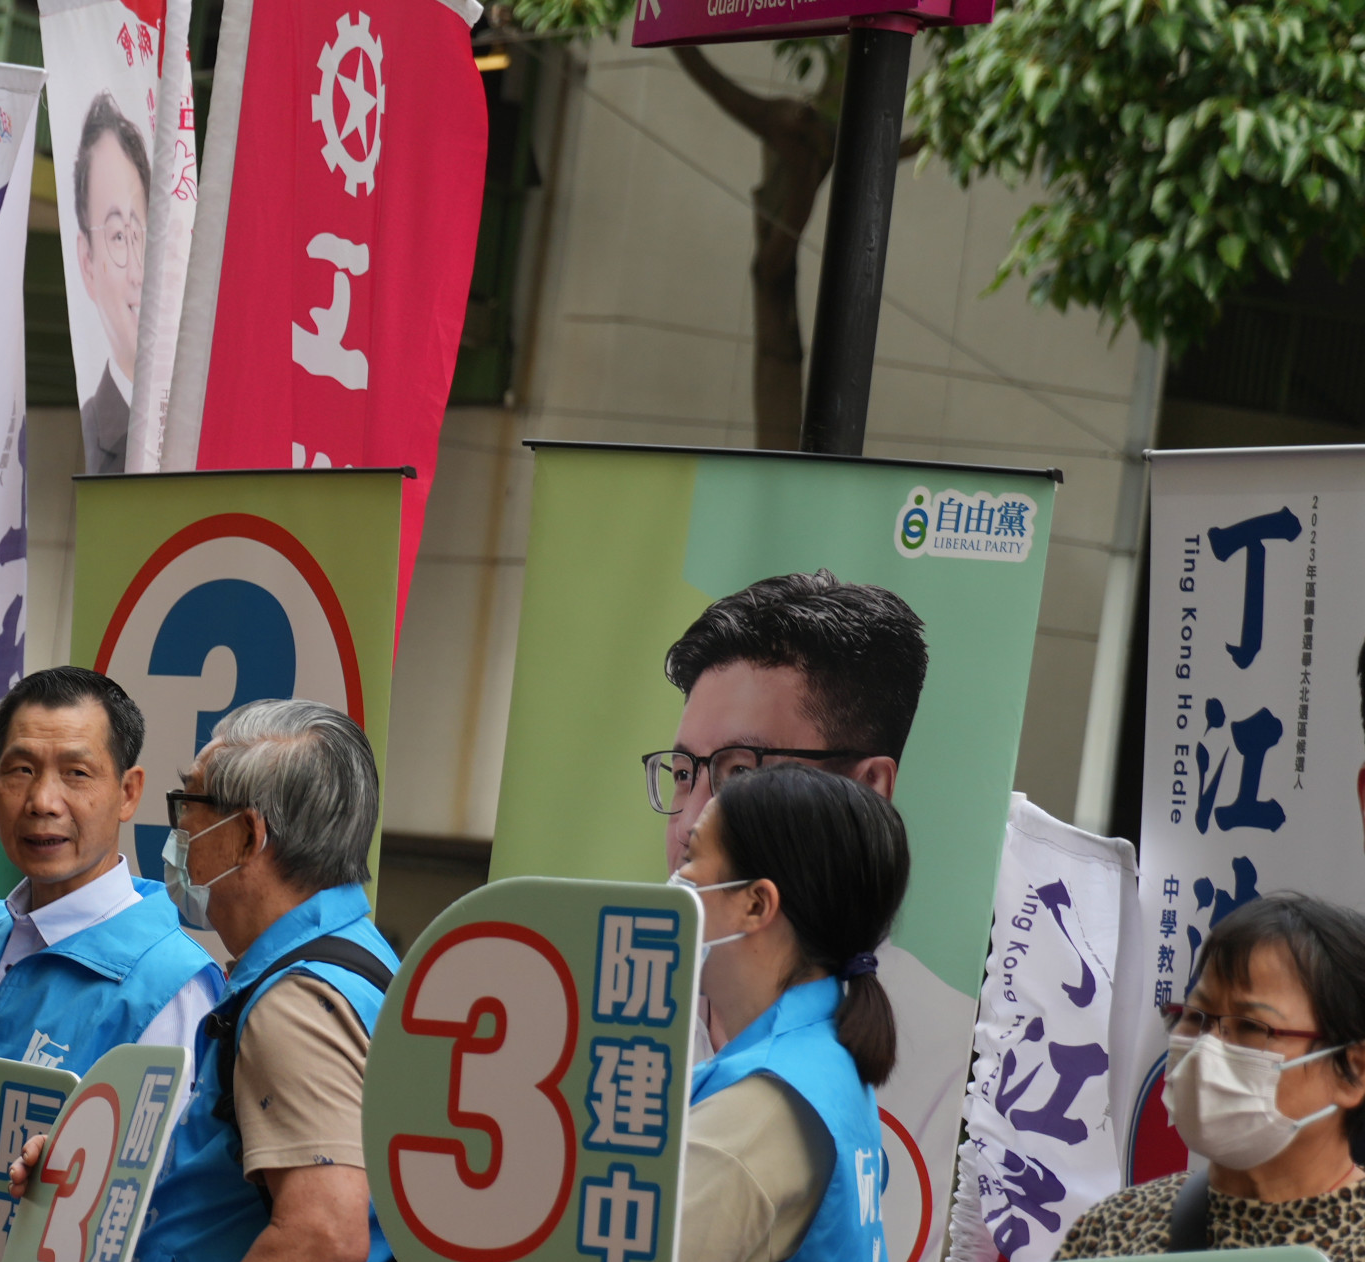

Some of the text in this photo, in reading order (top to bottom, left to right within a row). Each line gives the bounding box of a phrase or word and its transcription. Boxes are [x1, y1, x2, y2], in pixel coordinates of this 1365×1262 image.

[935, 497, 1030, 538] 自由黨
[933, 536, 1025, 555] LIBERAL PARTY
[1170, 534, 1200, 825] Ting Kong Ho Eddie
